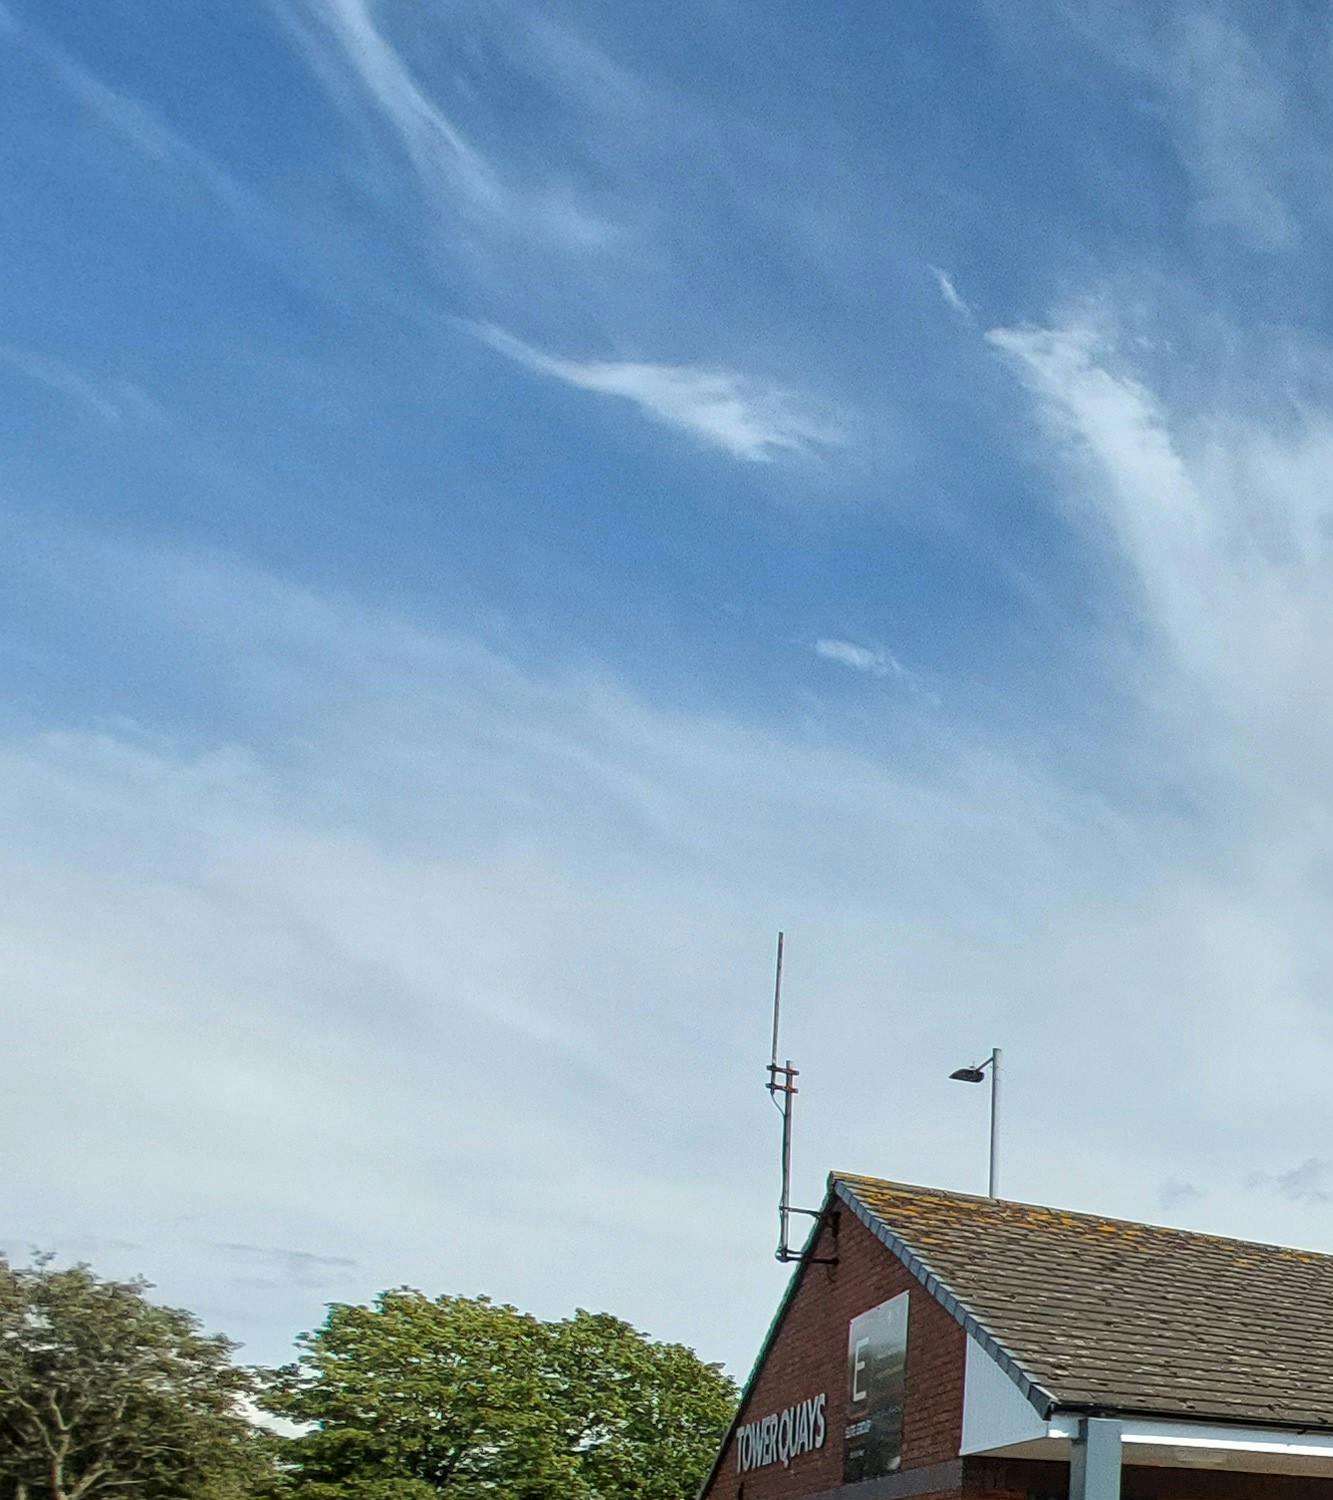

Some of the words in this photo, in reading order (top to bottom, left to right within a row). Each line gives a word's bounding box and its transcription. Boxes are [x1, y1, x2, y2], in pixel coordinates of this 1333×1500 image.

[853, 1336, 870, 1402] E
[736, 1413, 778, 1474] TOWER
[778, 1392, 826, 1469] QUAYS
